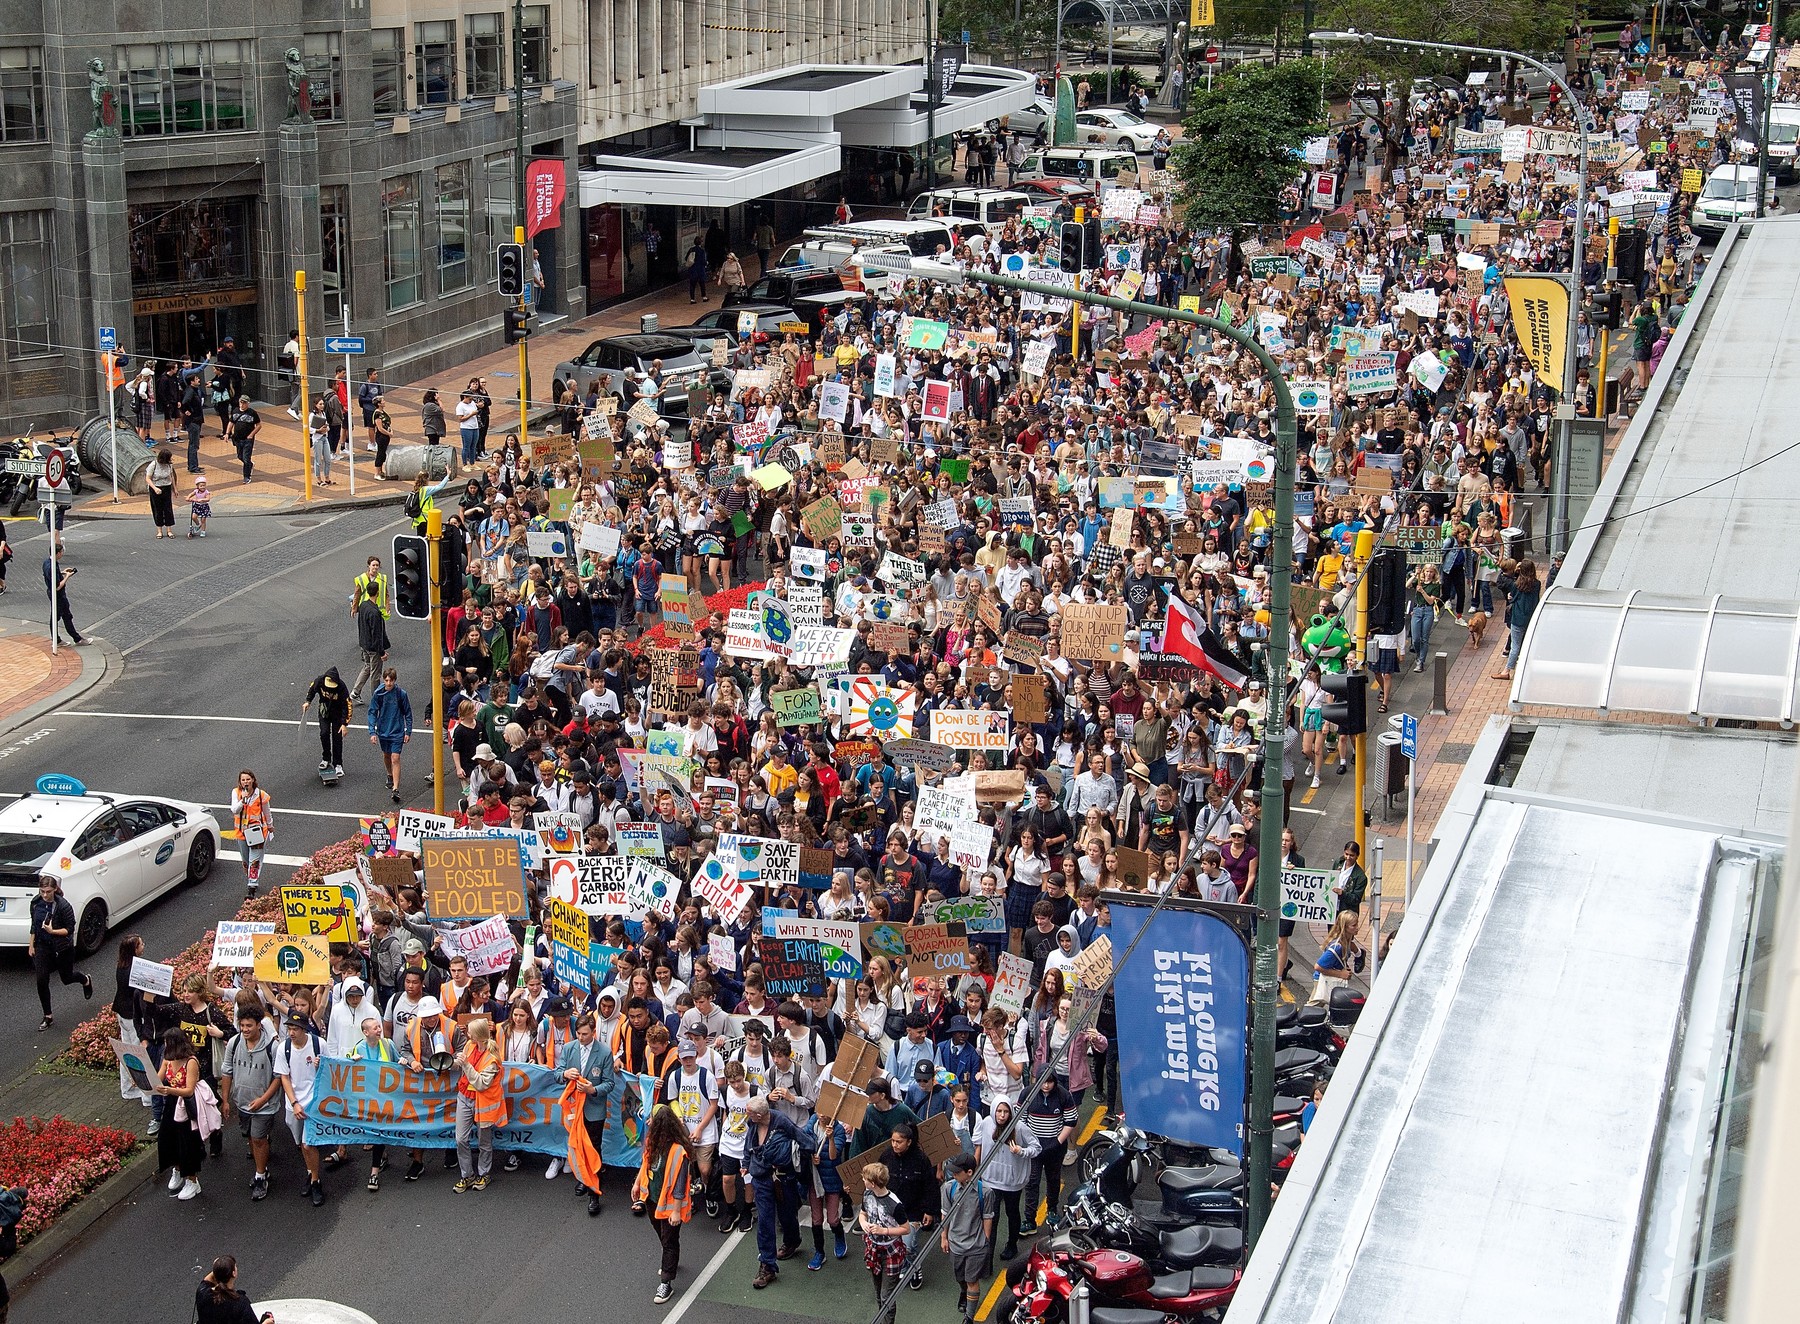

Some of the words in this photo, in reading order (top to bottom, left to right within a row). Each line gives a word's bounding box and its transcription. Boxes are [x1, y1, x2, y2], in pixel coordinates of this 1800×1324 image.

[1691, 107, 1718, 115] WORLD
[545, 174, 553, 195] Piki
[1253, 260, 1274, 268] Save
[1028, 270, 1064, 280] CLEAN
[1122, 278, 1139, 290] ACTION
[138, 300, 153, 311] 143
[157, 296, 203, 310] LAMBTON
[208, 294, 233, 305] QUAY
[1349, 367, 1395, 381] PROTECT
[588, 419, 606, 427] CLIMATE
[741, 435, 767, 446] PLANET
[824, 434, 843, 443] STOP
[824, 444, 843, 453] GLOBAL
[10, 461, 33, 472] STOUT
[50, 460, 61, 475] 50
[842, 480, 860, 490] OUR
[861, 477, 880, 487] FIGHT
[1247, 483, 1270, 491] STOP
[843, 516, 858, 524] SAVE
[1003, 512, 1029, 522] DROWN
[844, 537, 872, 546] PLANET
[890, 560, 911, 570] THIS
[913, 564, 923, 573] IS
[665, 601, 687, 613] NOT
[791, 604, 822, 614] GREAT
[1064, 606, 1101, 619] CLEAN
[1106, 607, 1121, 619] UP
[664, 623, 695, 634] DISASTERS
[1065, 621, 1083, 634] OUR
[728, 635, 750, 646] TEACH
[799, 630, 841, 641] WE'RE
[1019, 634, 1044, 646] CLIMATE
[1085, 634, 1107, 648] NOT
[783, 647, 793, 657] UP
[1005, 645, 1020, 654] WHY
[652, 650, 669, 659] WHY
[670, 652, 695, 663] SHOULD
[1140, 653, 1158, 661] WHICH
[826, 661, 848, 670] PLANET
[1015, 677, 1045, 686] THERE
[784, 692, 813, 708] FOR
[1019, 693, 1033, 702] NO
[1014, 702, 1045, 713] PLANET
[968, 714, 979, 725] BE
[1406, 717, 1413, 726] P
[938, 730, 983, 746] FOSSIL
[983, 732, 1007, 746] FOOL
[1406, 727, 1414, 737] 120
[927, 790, 949, 800] TREAT
[950, 796, 965, 806] THE
[920, 798, 945, 810] PLANET
[945, 805, 960, 814] LIKE
[425, 820, 446, 831] OUR
[616, 823, 643, 831] RESPECT
[643, 823, 657, 831] OUR
[765, 844, 797, 857] SAVE
[428, 848, 486, 868] DON'T
[495, 848, 518, 866] BE
[578, 858, 603, 867] BACK
[605, 857, 624, 866] THE
[766, 857, 790, 869] OUR
[955, 851, 981, 869] WORLD
[579, 867, 625, 882] ZERO
[634, 857, 660, 878] THERE
[662, 873, 671, 884] IS
[761, 869, 797, 882] EARTH
[375, 874, 413, 882] PLANET
[445, 870, 504, 889] FOSSIL
[1280, 872, 1326, 889] RESPECT
[580, 882, 625, 892] CARBON
[284, 890, 313, 900] THERE
[315, 890, 331, 901] IS
[581, 892, 604, 905] ACT
[608, 892, 627, 904] NZ
[628, 884, 662, 907] PLANET
[661, 900, 671, 914] B
[695, 876, 738, 920] FUTURE
[1286, 889, 1315, 903] YOUR
[287, 903, 307, 917] NO
[434, 891, 522, 916] FOOLED
[552, 900, 587, 933] CHANGE
[310, 920, 321, 935] B
[778, 924, 807, 936] WHAT
[812, 926, 819, 937] I
[823, 927, 854, 939] STAND
[554, 925, 586, 952] POLITICS
[841, 939, 851, 951] 4
[912, 938, 965, 952] WARMING
[218, 947, 237, 957] THIS
[255, 939, 275, 962] THERE
[277, 935, 285, 944] IS
[287, 935, 298, 943] NO
[300, 937, 329, 962] PLANET
[759, 941, 784, 952] keep
[784, 941, 821, 963] EARTH
[1074, 937, 1109, 970] WITH
[284, 952, 300, 971] B
[555, 947, 569, 961] NOT
[572, 953, 588, 969] THE
[761, 953, 780, 964] the
[911, 951, 936, 964] NOT
[934, 951, 971, 970] COOL
[555, 962, 590, 990] CLIMATE
[764, 964, 804, 981] CLEAN
[767, 978, 809, 995] URANUS
[997, 971, 1027, 990] ACT
[1003, 988, 1014, 996] on
[330, 1064, 367, 1092] WE
[318, 1098, 456, 1126] CLIMATE
[315, 1123, 365, 1136] School
[510, 1129, 534, 1144] NZ
